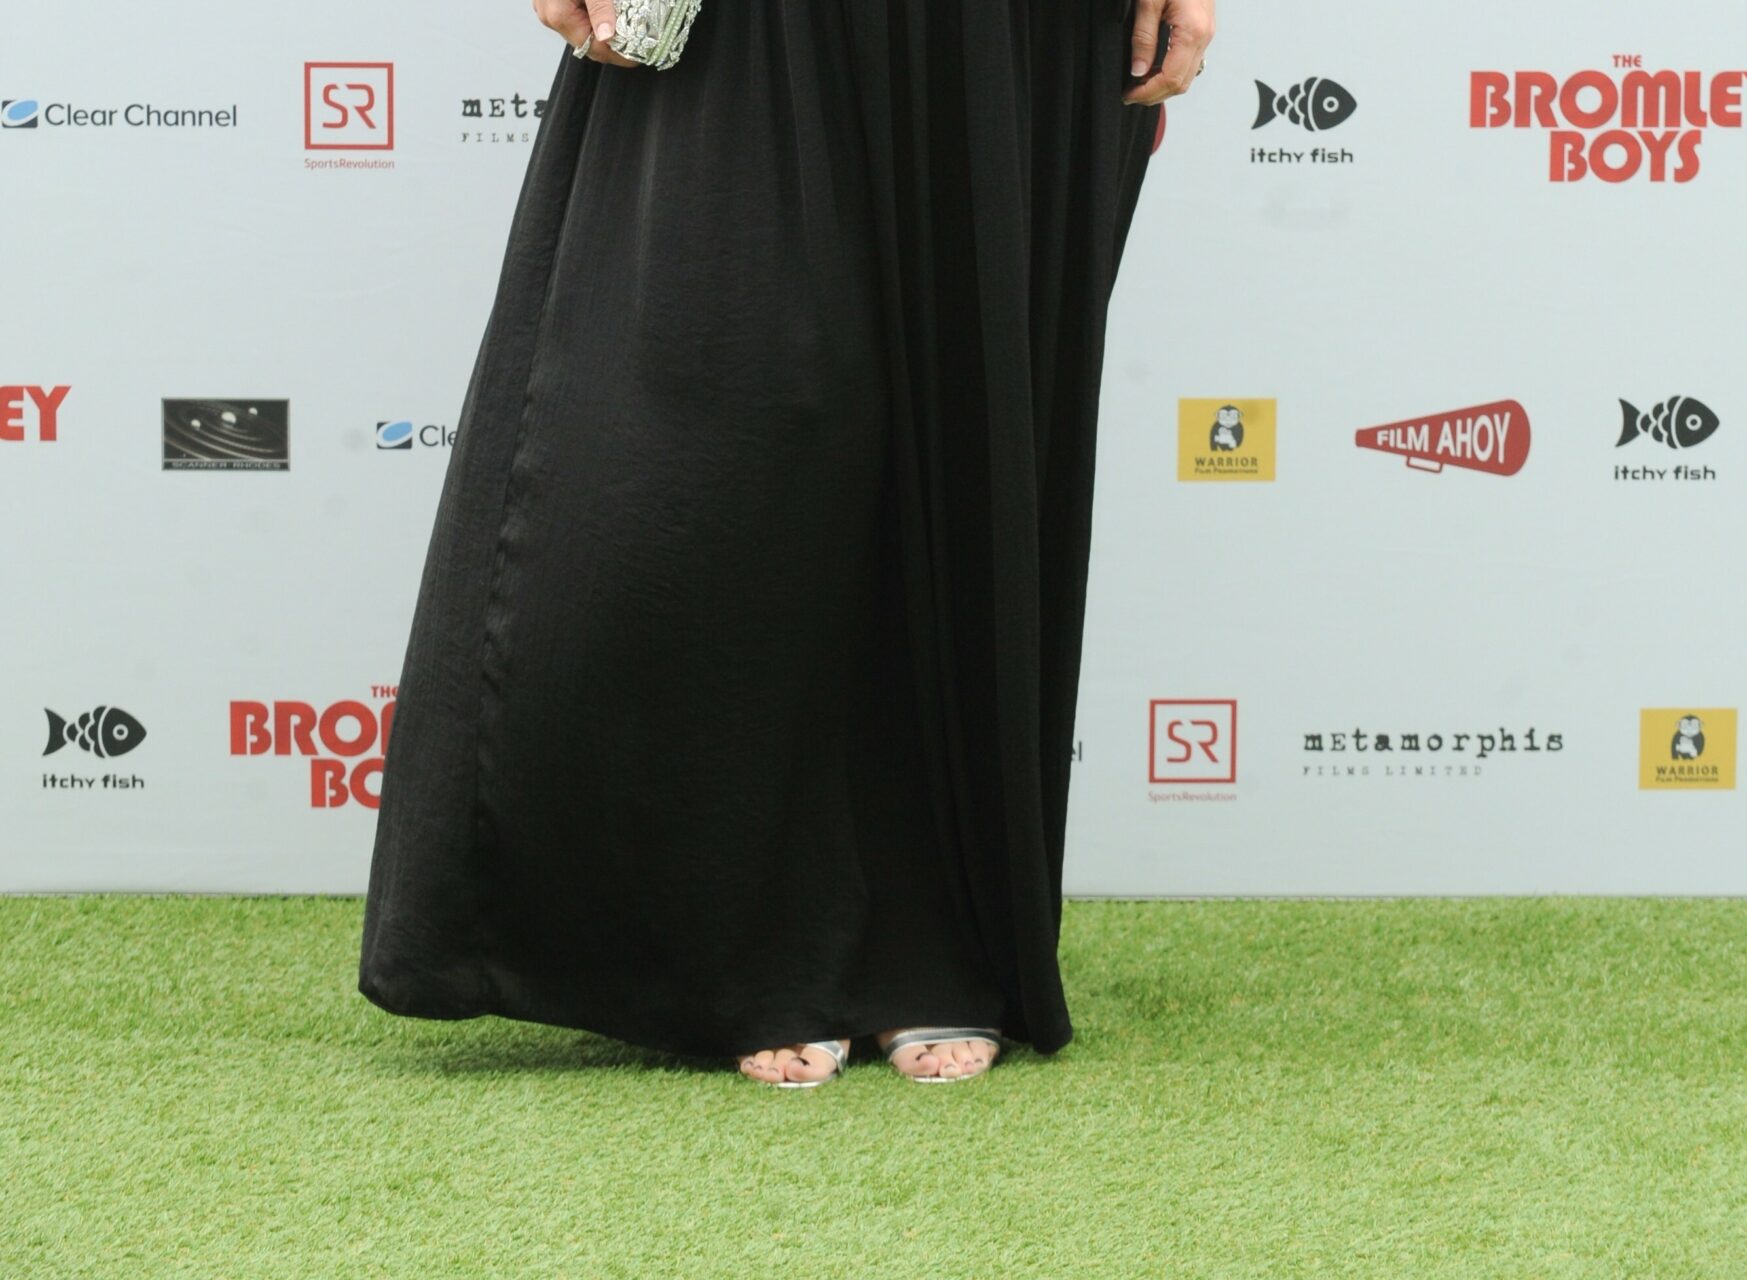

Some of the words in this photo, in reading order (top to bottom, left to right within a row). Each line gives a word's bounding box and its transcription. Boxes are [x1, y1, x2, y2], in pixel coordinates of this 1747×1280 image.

[1613, 55, 1641, 67] THE
[322, 84, 376, 129] SR
[1470, 71, 1747, 127] BROMLE
[45, 104, 118, 126] Clear
[124, 104, 236, 127] Channel
[462, 133, 529, 143] FILMS
[1251, 148, 1304, 163] itchy
[1310, 148, 1353, 163] fish
[1549, 131, 1702, 183] BOYS
[305, 158, 394, 170] SportsRevolution
[419, 425, 457, 447] Cle
[1377, 429, 1429, 451] FILM
[1437, 414, 1511, 464] AHOY
[1195, 457, 1259, 466] WARRIOR
[1615, 465, 1667, 480] itchy
[1673, 465, 1715, 480] fish
[1167, 720, 1218, 763] SR
[1656, 766, 1719, 775] WARRIOR
[43, 774, 95, 788] itchy
[102, 774, 144, 788] fish
[310, 758, 385, 809] BO
[1149, 792, 1236, 802] SportsRevolution
